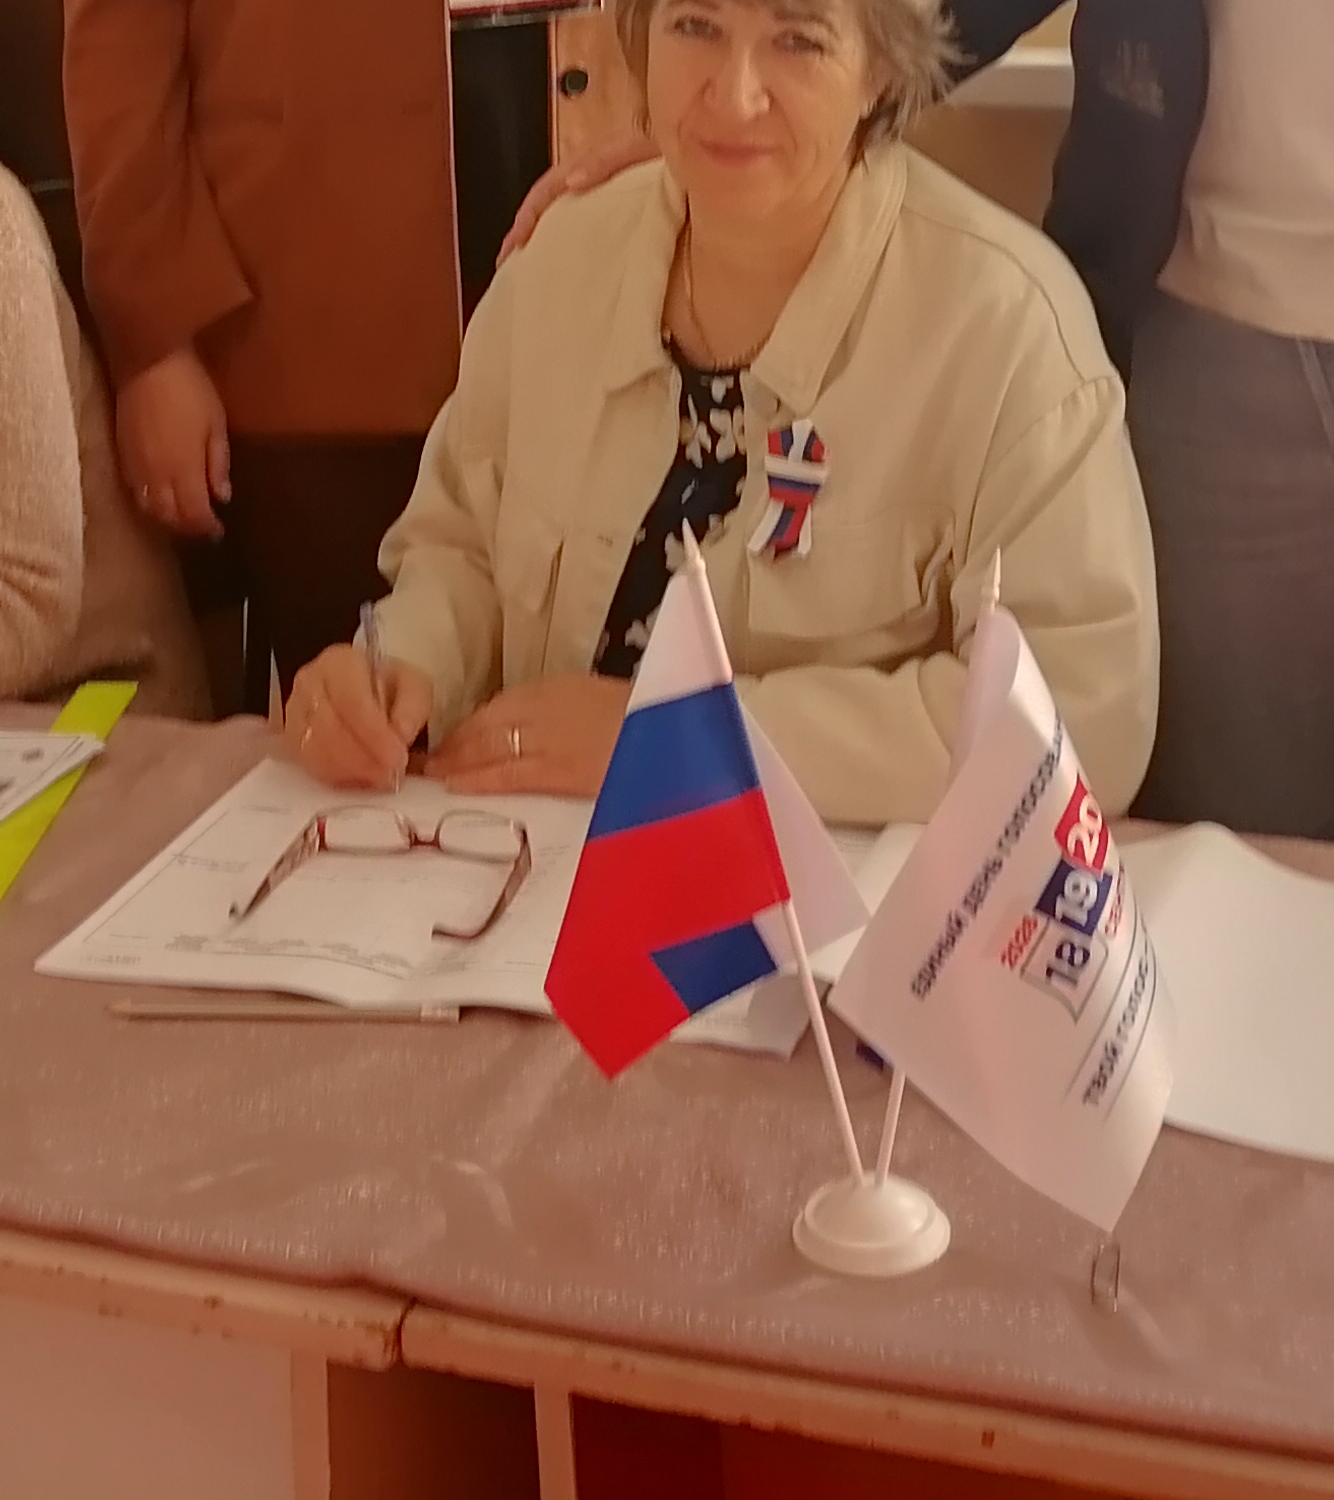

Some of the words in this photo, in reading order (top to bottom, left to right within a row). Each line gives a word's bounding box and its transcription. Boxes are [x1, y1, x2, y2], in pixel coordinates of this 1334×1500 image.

[1067, 793, 1102, 868] 20
[911, 909, 968, 1001] ЕДИНЫЙ
[963, 858, 1003, 919] ДЕНЬ
[1055, 870, 1098, 927] 19
[1045, 941, 1091, 988] 18
[1083, 1040, 1123, 1106] ТВОЙ
[1117, 957, 1149, 1043] ГОЛОС
